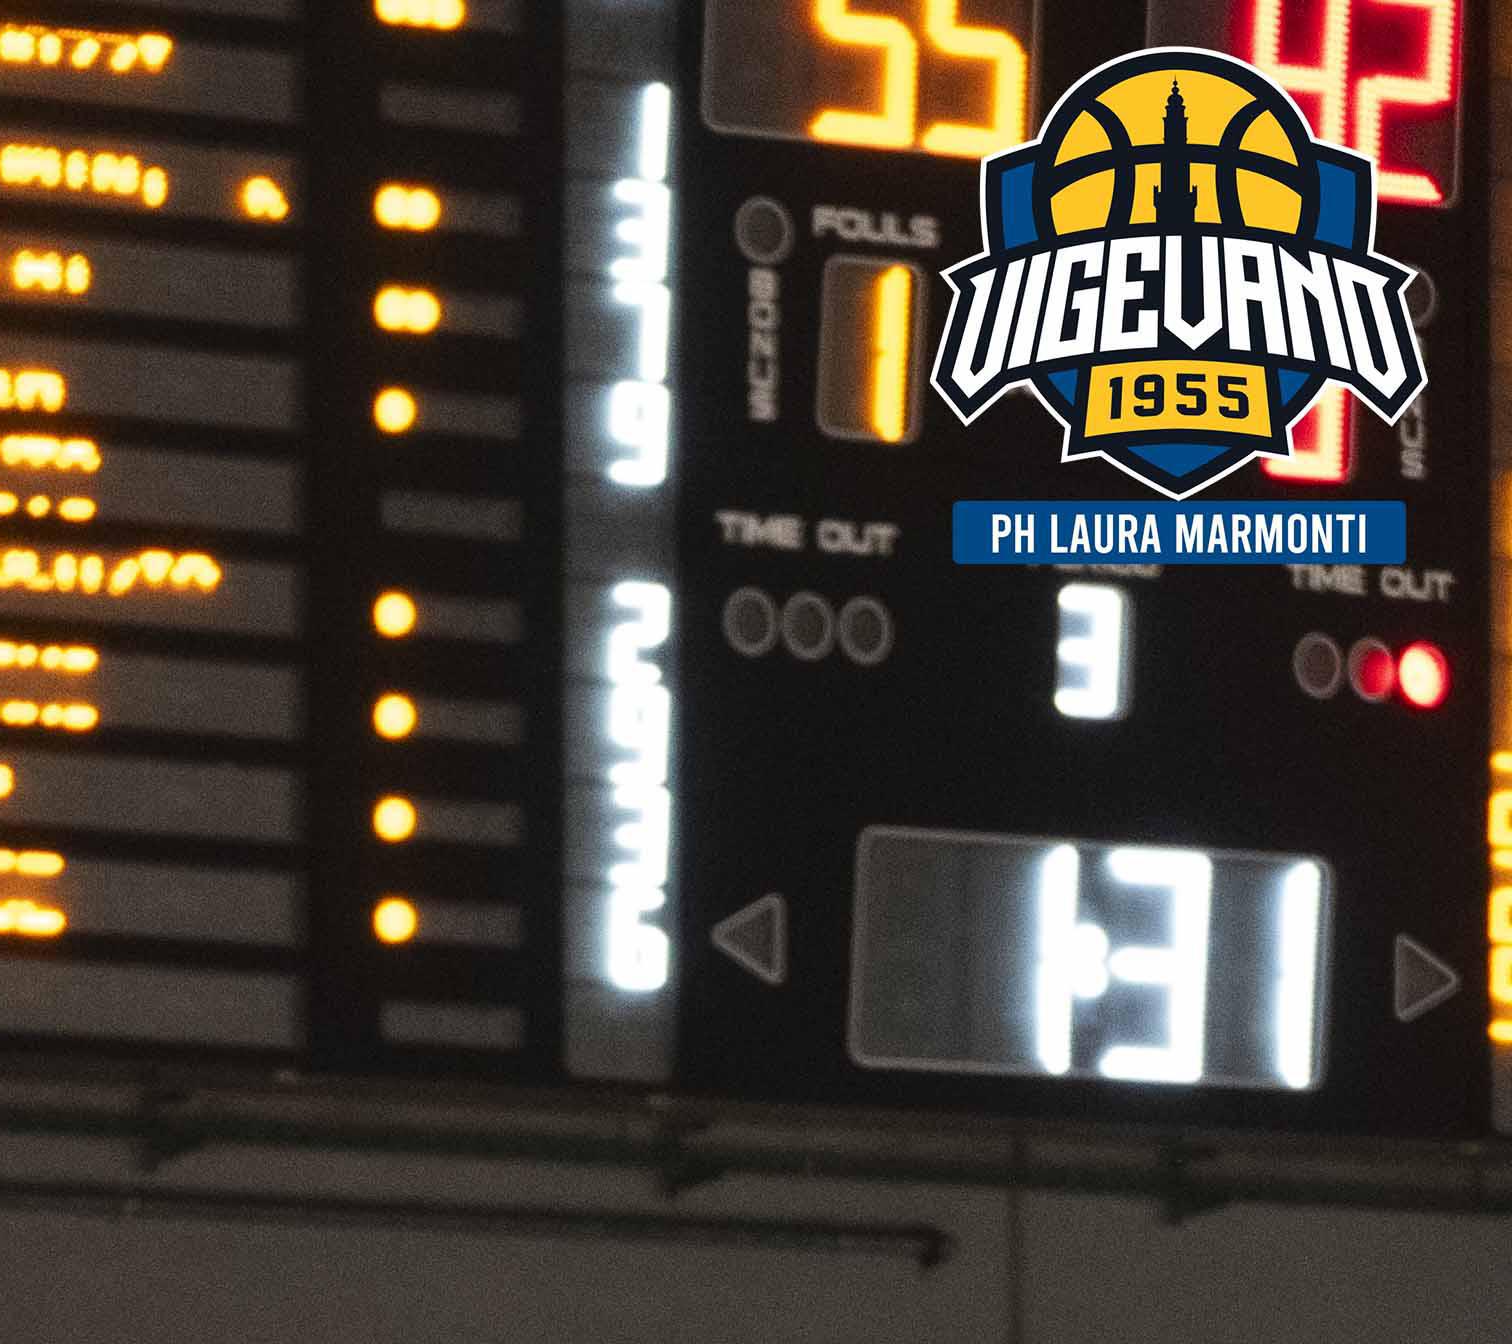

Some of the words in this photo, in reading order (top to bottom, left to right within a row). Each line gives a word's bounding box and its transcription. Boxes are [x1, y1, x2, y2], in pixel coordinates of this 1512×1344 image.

[811, 205, 940, 249] FOULS
[718, 510, 805, 548] TIME
[818, 517, 901, 557] OUT
